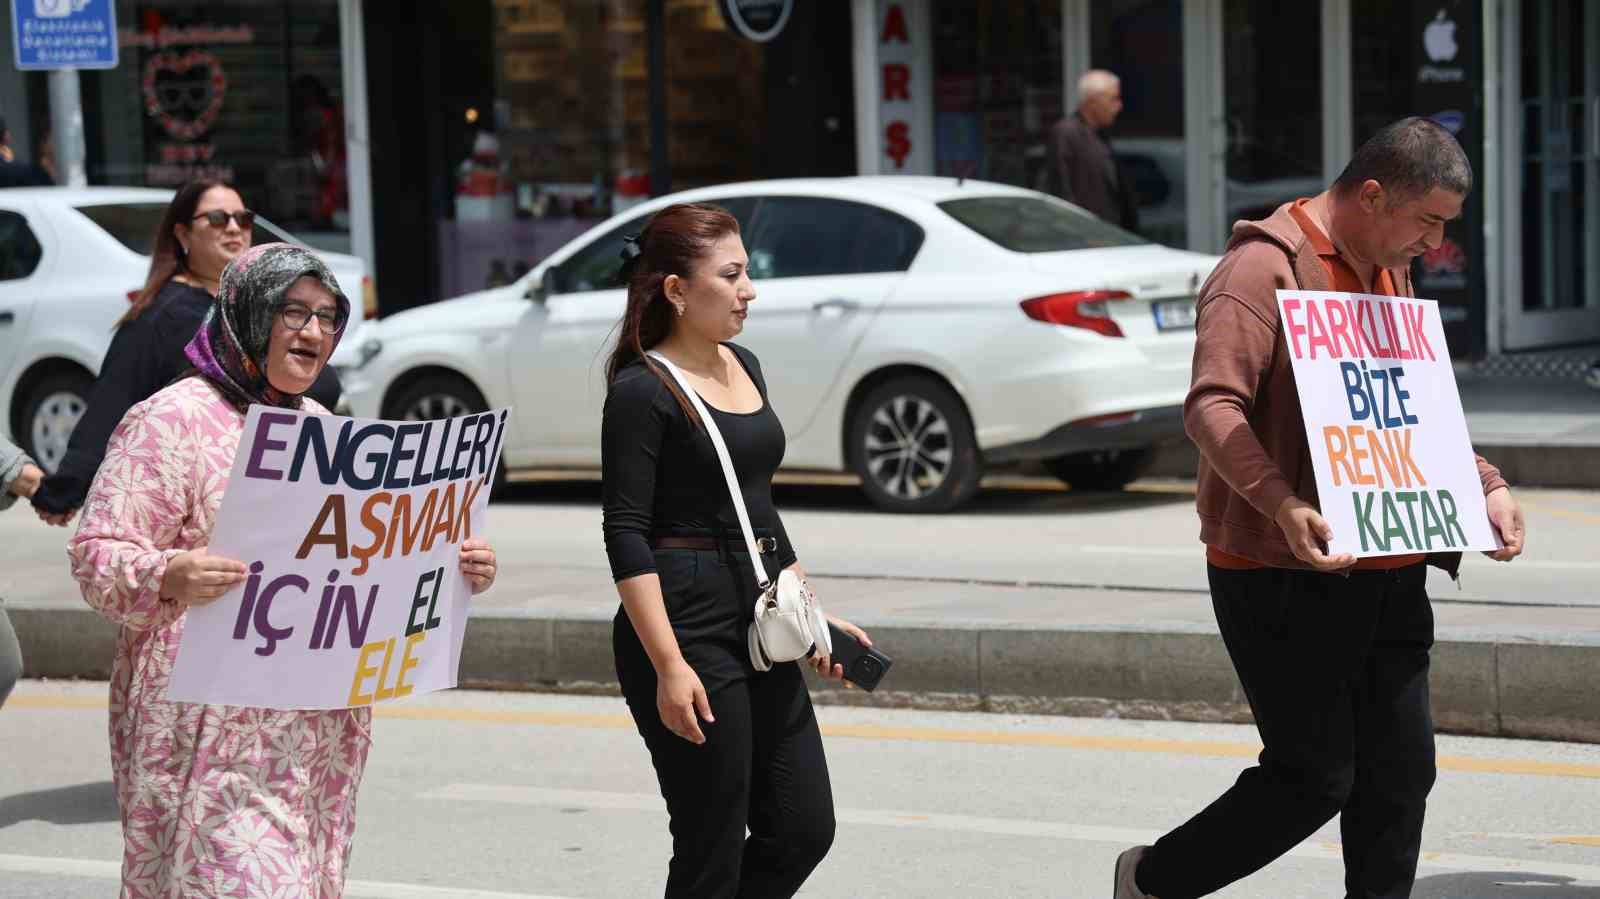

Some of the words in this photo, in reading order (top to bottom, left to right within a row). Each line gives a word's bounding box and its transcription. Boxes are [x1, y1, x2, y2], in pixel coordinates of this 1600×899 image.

[1283, 299, 1437, 362] FARKLILIK
[1340, 359, 1419, 430] BİZE
[245, 408, 508, 490] ENGELLERİ
[1323, 424, 1427, 489] RENK
[295, 476, 484, 577] AŞMAK
[1353, 488, 1469, 553] KATAR
[404, 566, 446, 638] EL
[346, 631, 427, 707] ELE
